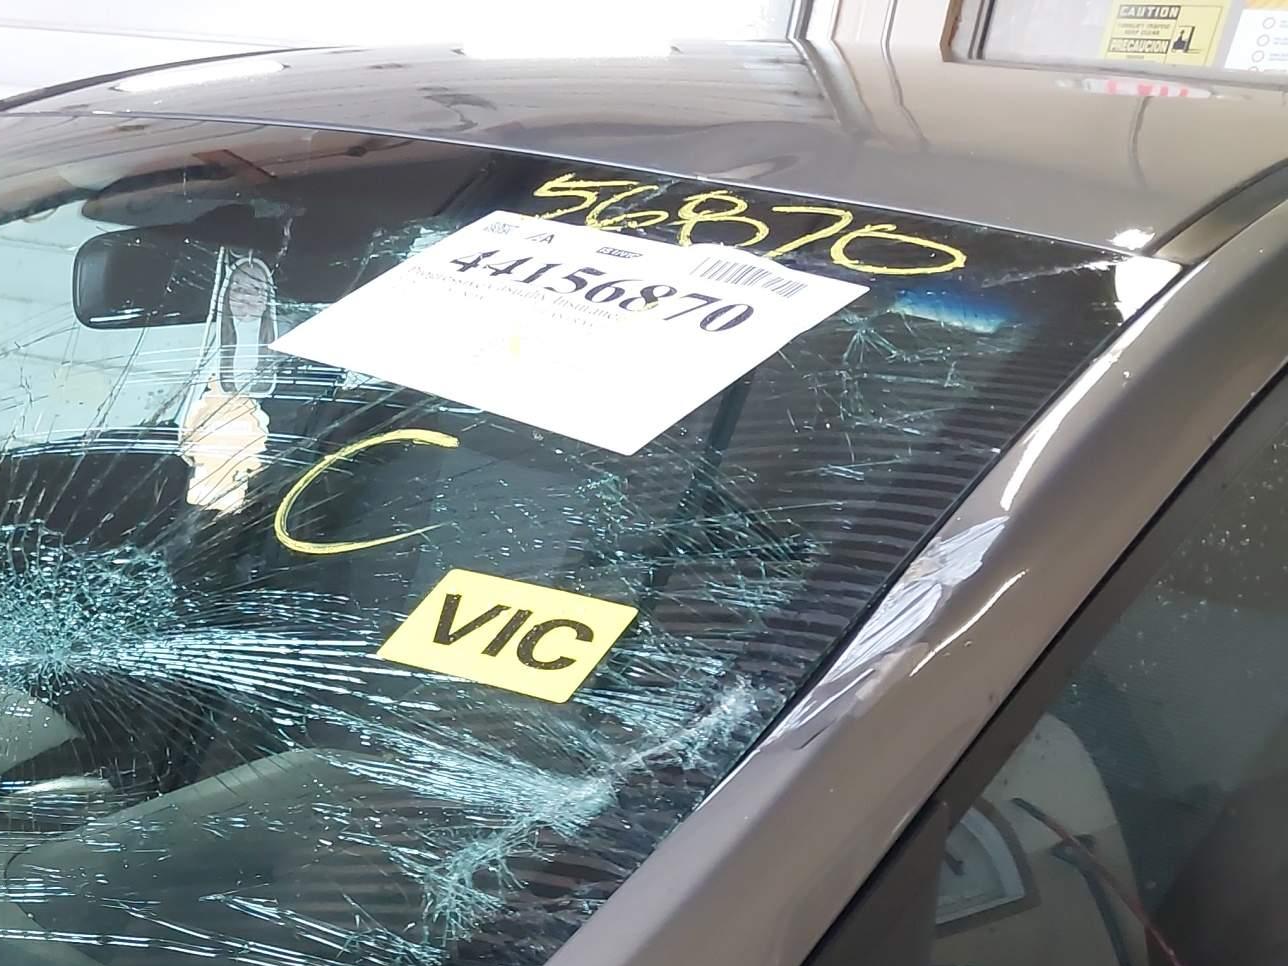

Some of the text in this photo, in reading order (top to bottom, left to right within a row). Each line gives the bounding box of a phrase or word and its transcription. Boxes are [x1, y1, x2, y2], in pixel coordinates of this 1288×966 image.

[1119, 6, 1179, 18] CAUTION
[523, 173, 968, 276] 56870
[450, 249, 754, 332] 44156870
[274, 428, 459, 555] C
[433, 593, 595, 671] VIC
